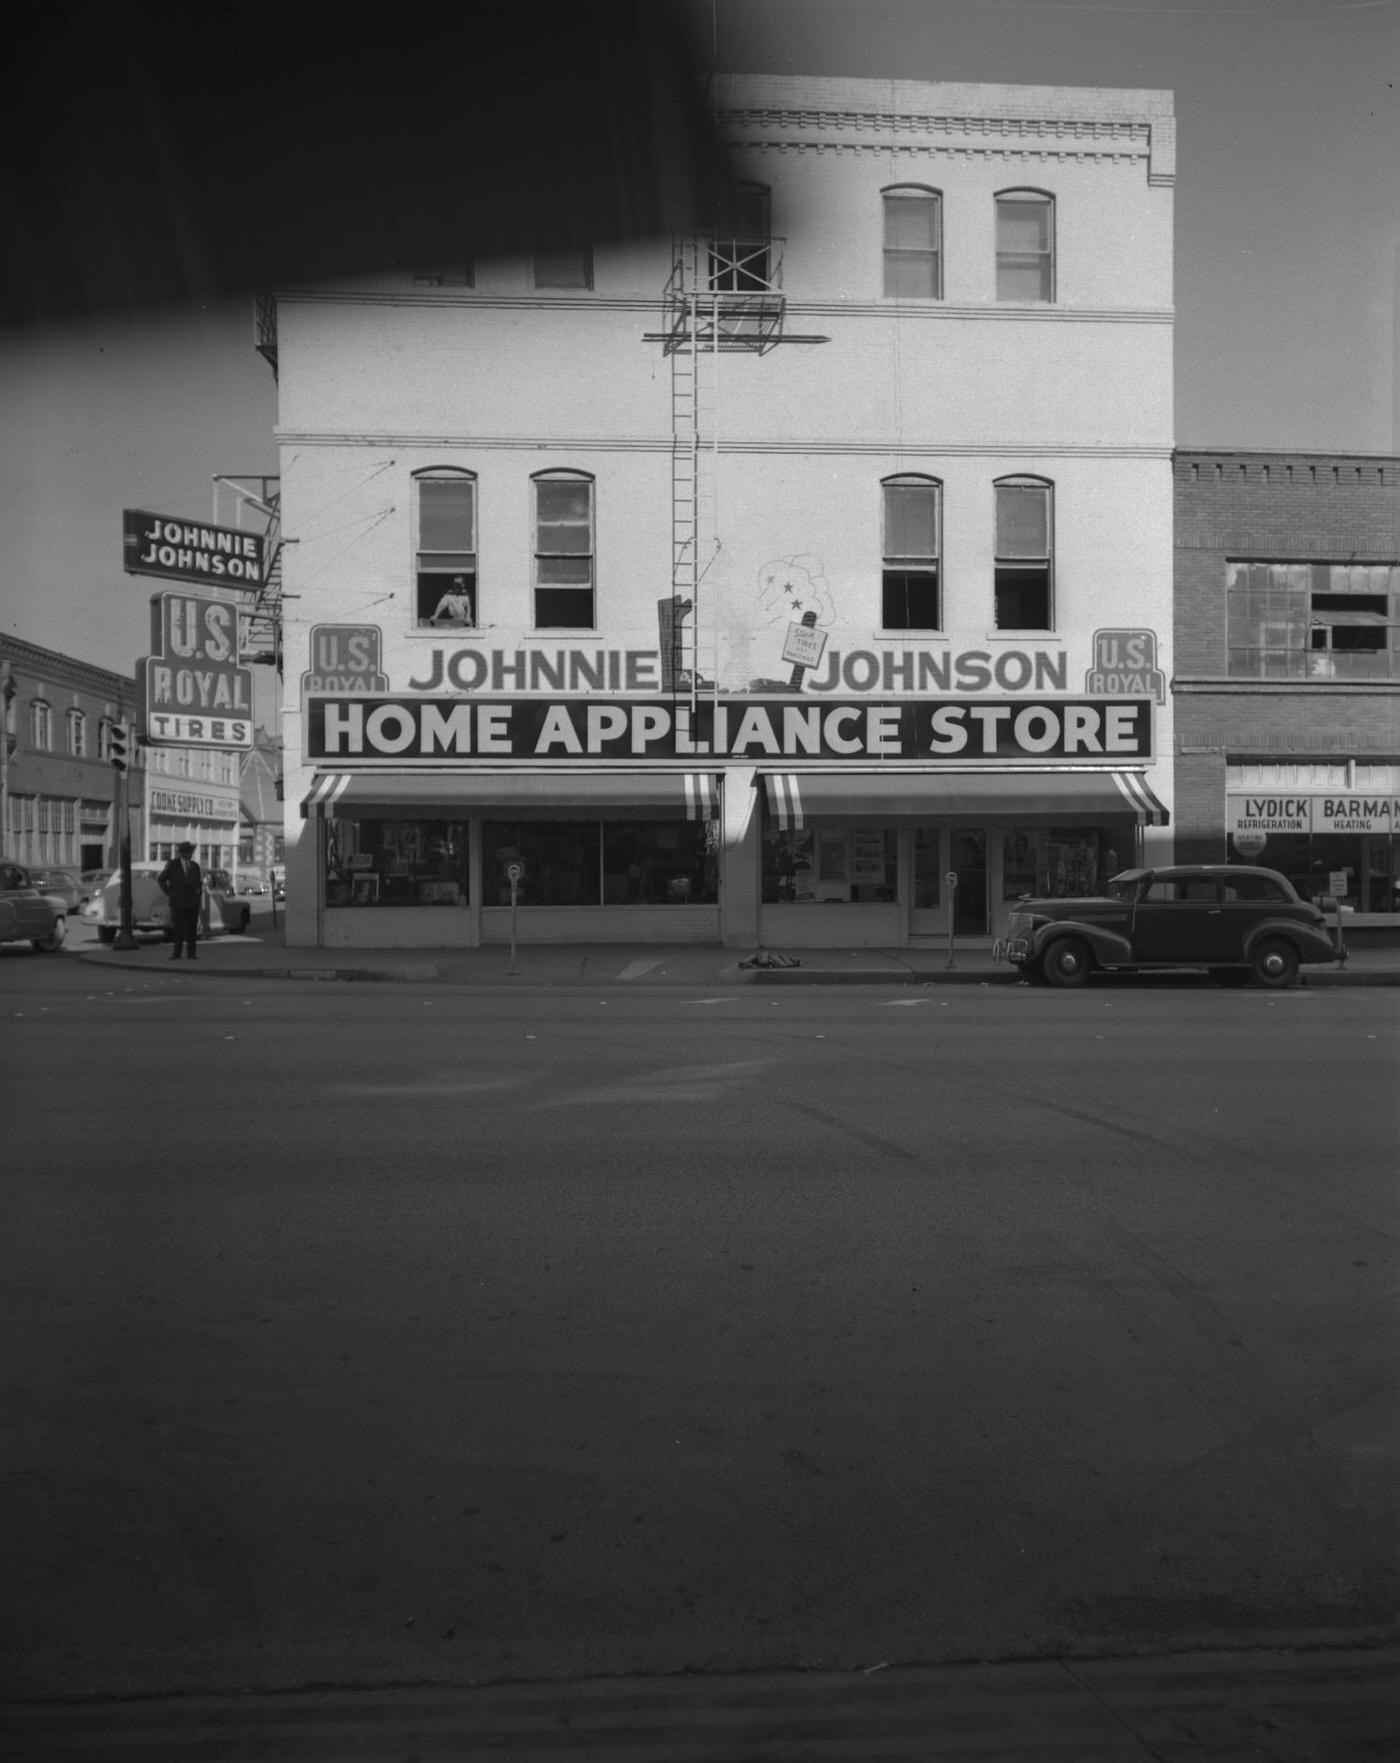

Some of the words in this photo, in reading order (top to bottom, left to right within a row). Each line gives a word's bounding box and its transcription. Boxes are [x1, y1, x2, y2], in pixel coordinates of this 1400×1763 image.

[147, 519, 257, 558] JOHNNIE
[141, 543, 260, 581] JOHNSON
[168, 596, 236, 662] U.S.
[319, 634, 376, 673] U.S.
[408, 649, 660, 691] JOHNNIE
[808, 649, 1067, 692] JOHNSON
[1100, 637, 1152, 670] U.S.
[154, 667, 249, 711] ROYAL
[1093, 673, 1157, 694] ROYAL
[155, 716, 247, 742] TIRES
[324, 703, 513, 755] HOME
[533, 704, 904, 756] APPLIANCE
[929, 705, 1139, 755] STORE
[178, 795, 204, 815] SUPPLY
[1245, 798, 1308, 818] LYDICK
[1237, 819, 1303, 830] REFRIGERATION
[1333, 820, 1372, 831] HEATING
